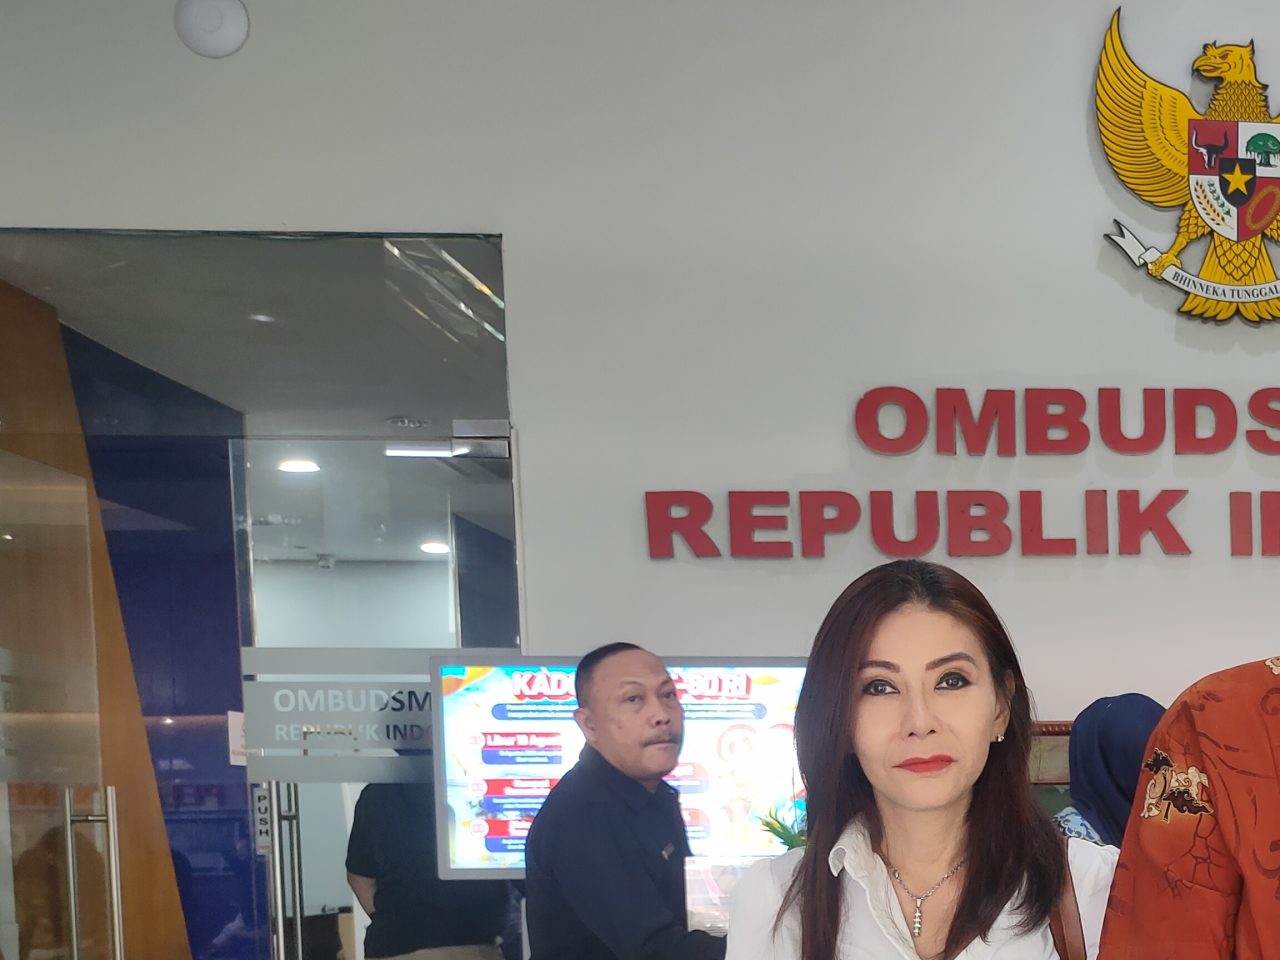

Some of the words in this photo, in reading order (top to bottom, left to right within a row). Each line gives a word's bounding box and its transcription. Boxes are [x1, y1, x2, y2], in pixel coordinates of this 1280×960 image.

[1172, 271, 1226, 298] BHINNEKA
[645, 490, 1191, 559] REPUBLIK
[273, 689, 432, 712] OMBUDSM
[257, 795, 269, 837] PUSH
